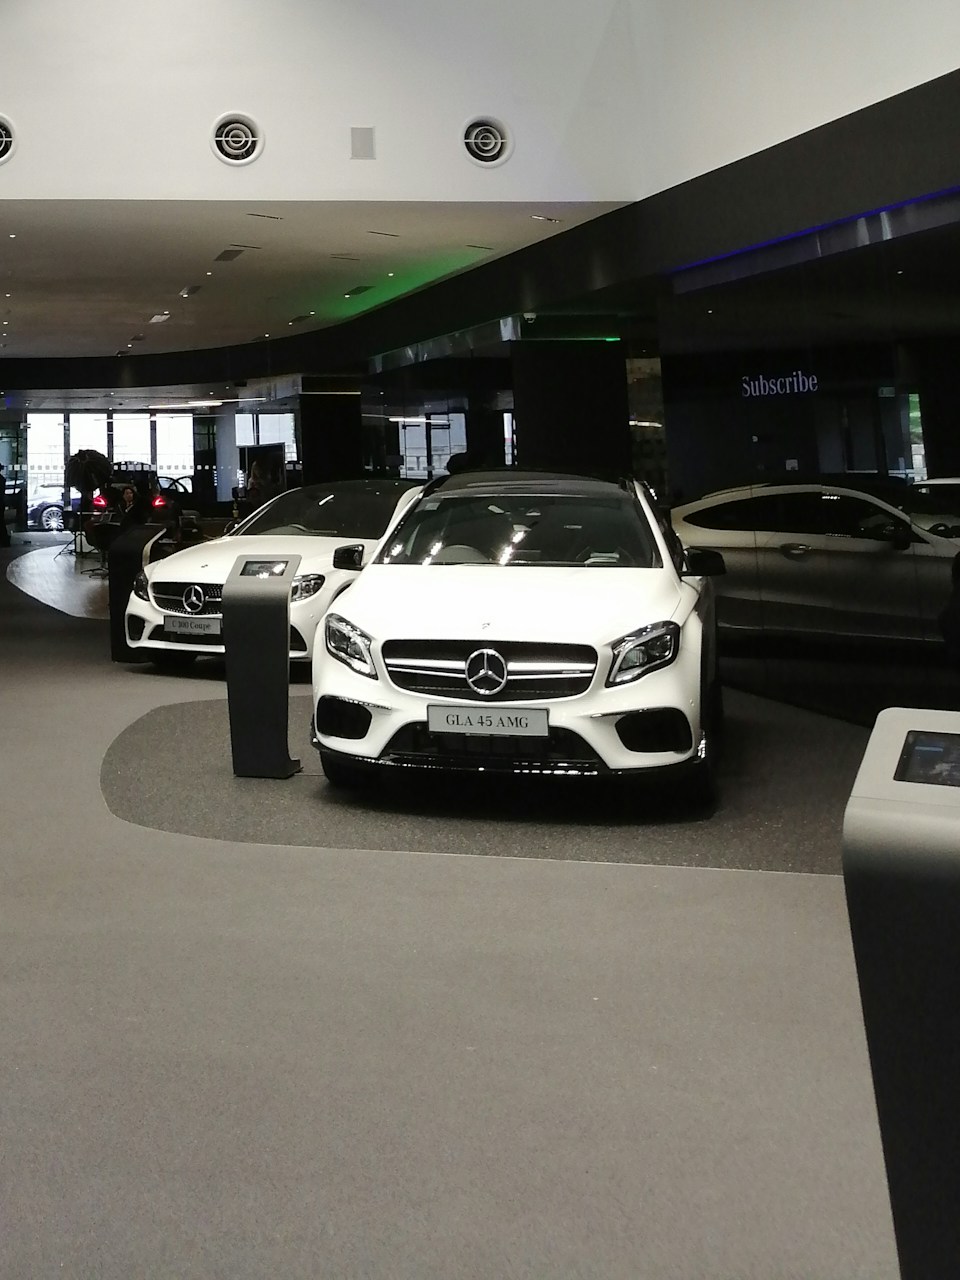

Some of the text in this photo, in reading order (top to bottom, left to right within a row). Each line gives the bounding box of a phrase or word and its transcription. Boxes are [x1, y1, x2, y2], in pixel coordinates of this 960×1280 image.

[742, 370, 819, 398] Subscribe
[446, 714, 529, 728] GLA 45 AMG
